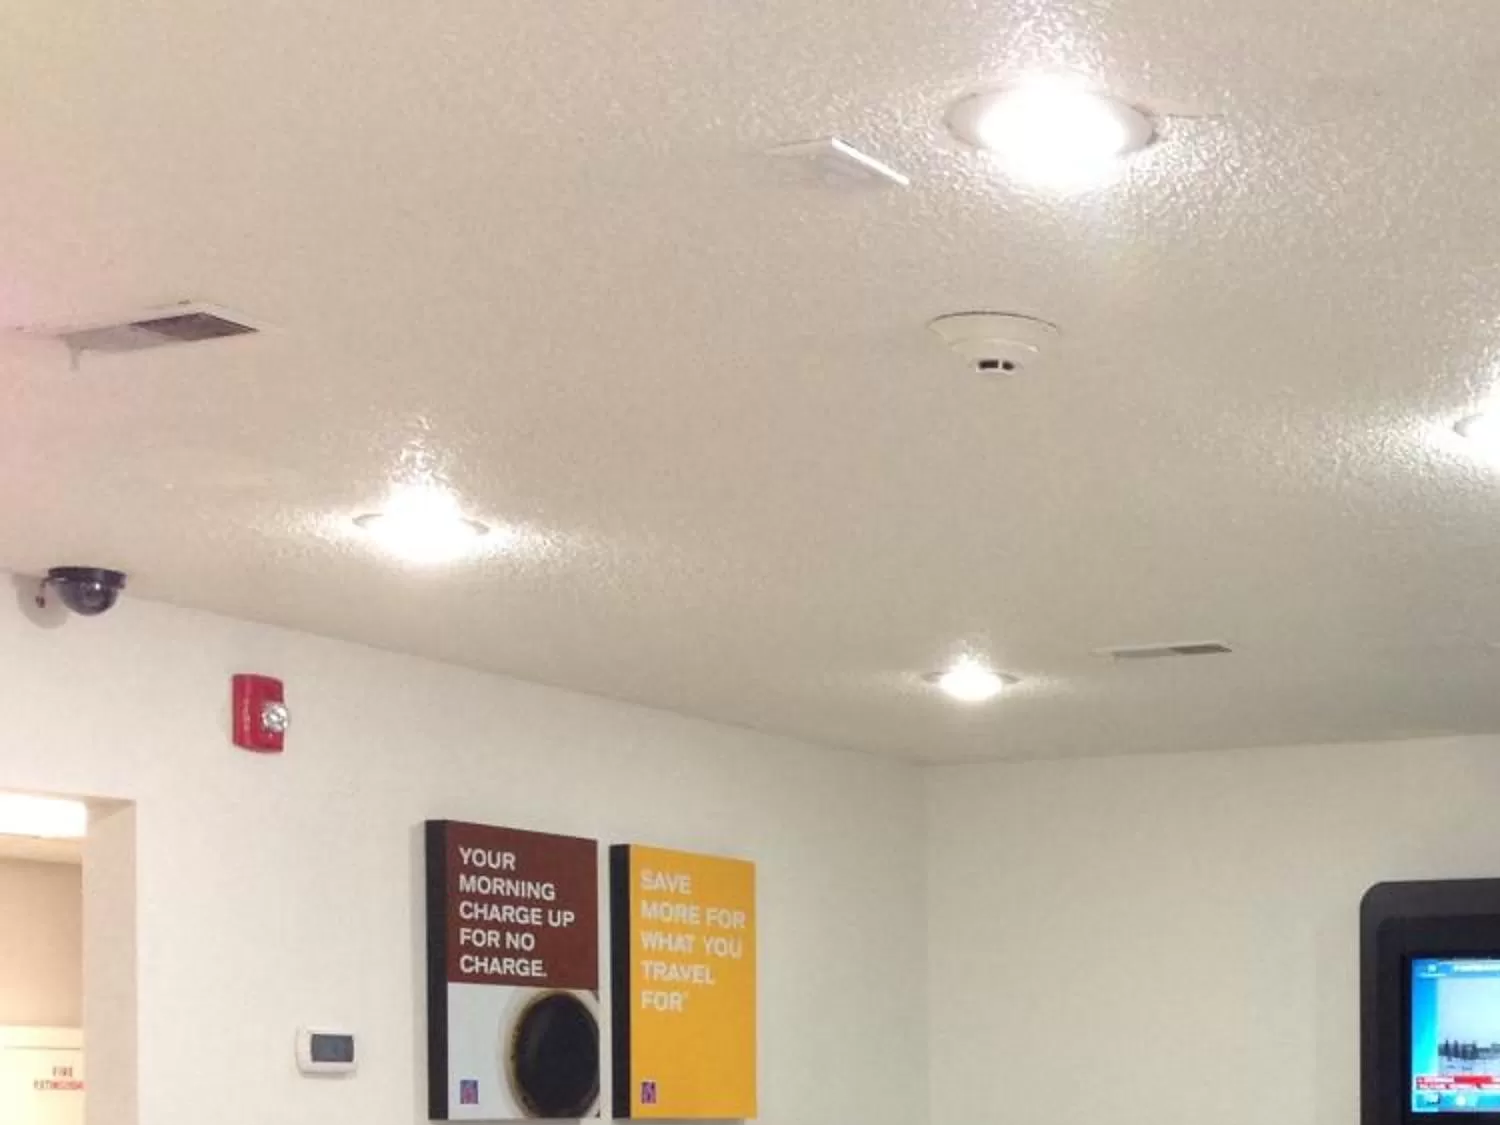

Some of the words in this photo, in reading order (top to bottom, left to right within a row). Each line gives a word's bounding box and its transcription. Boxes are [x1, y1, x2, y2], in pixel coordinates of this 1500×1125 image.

[459, 846, 516, 871] YOUR
[459, 873, 556, 901] MORNING
[640, 869, 692, 895] SAVE
[459, 900, 542, 925] CHARGE
[547, 909, 575, 927] UP
[641, 899, 700, 925] MORE
[705, 906, 745, 929] FOR
[459, 927, 500, 948] FOR
[505, 931, 535, 952] NO
[640, 930, 695, 954] WHAT
[703, 935, 742, 959] YOU
[459, 954, 548, 978] CHARGE.
[640, 959, 715, 986] TRAVEL
